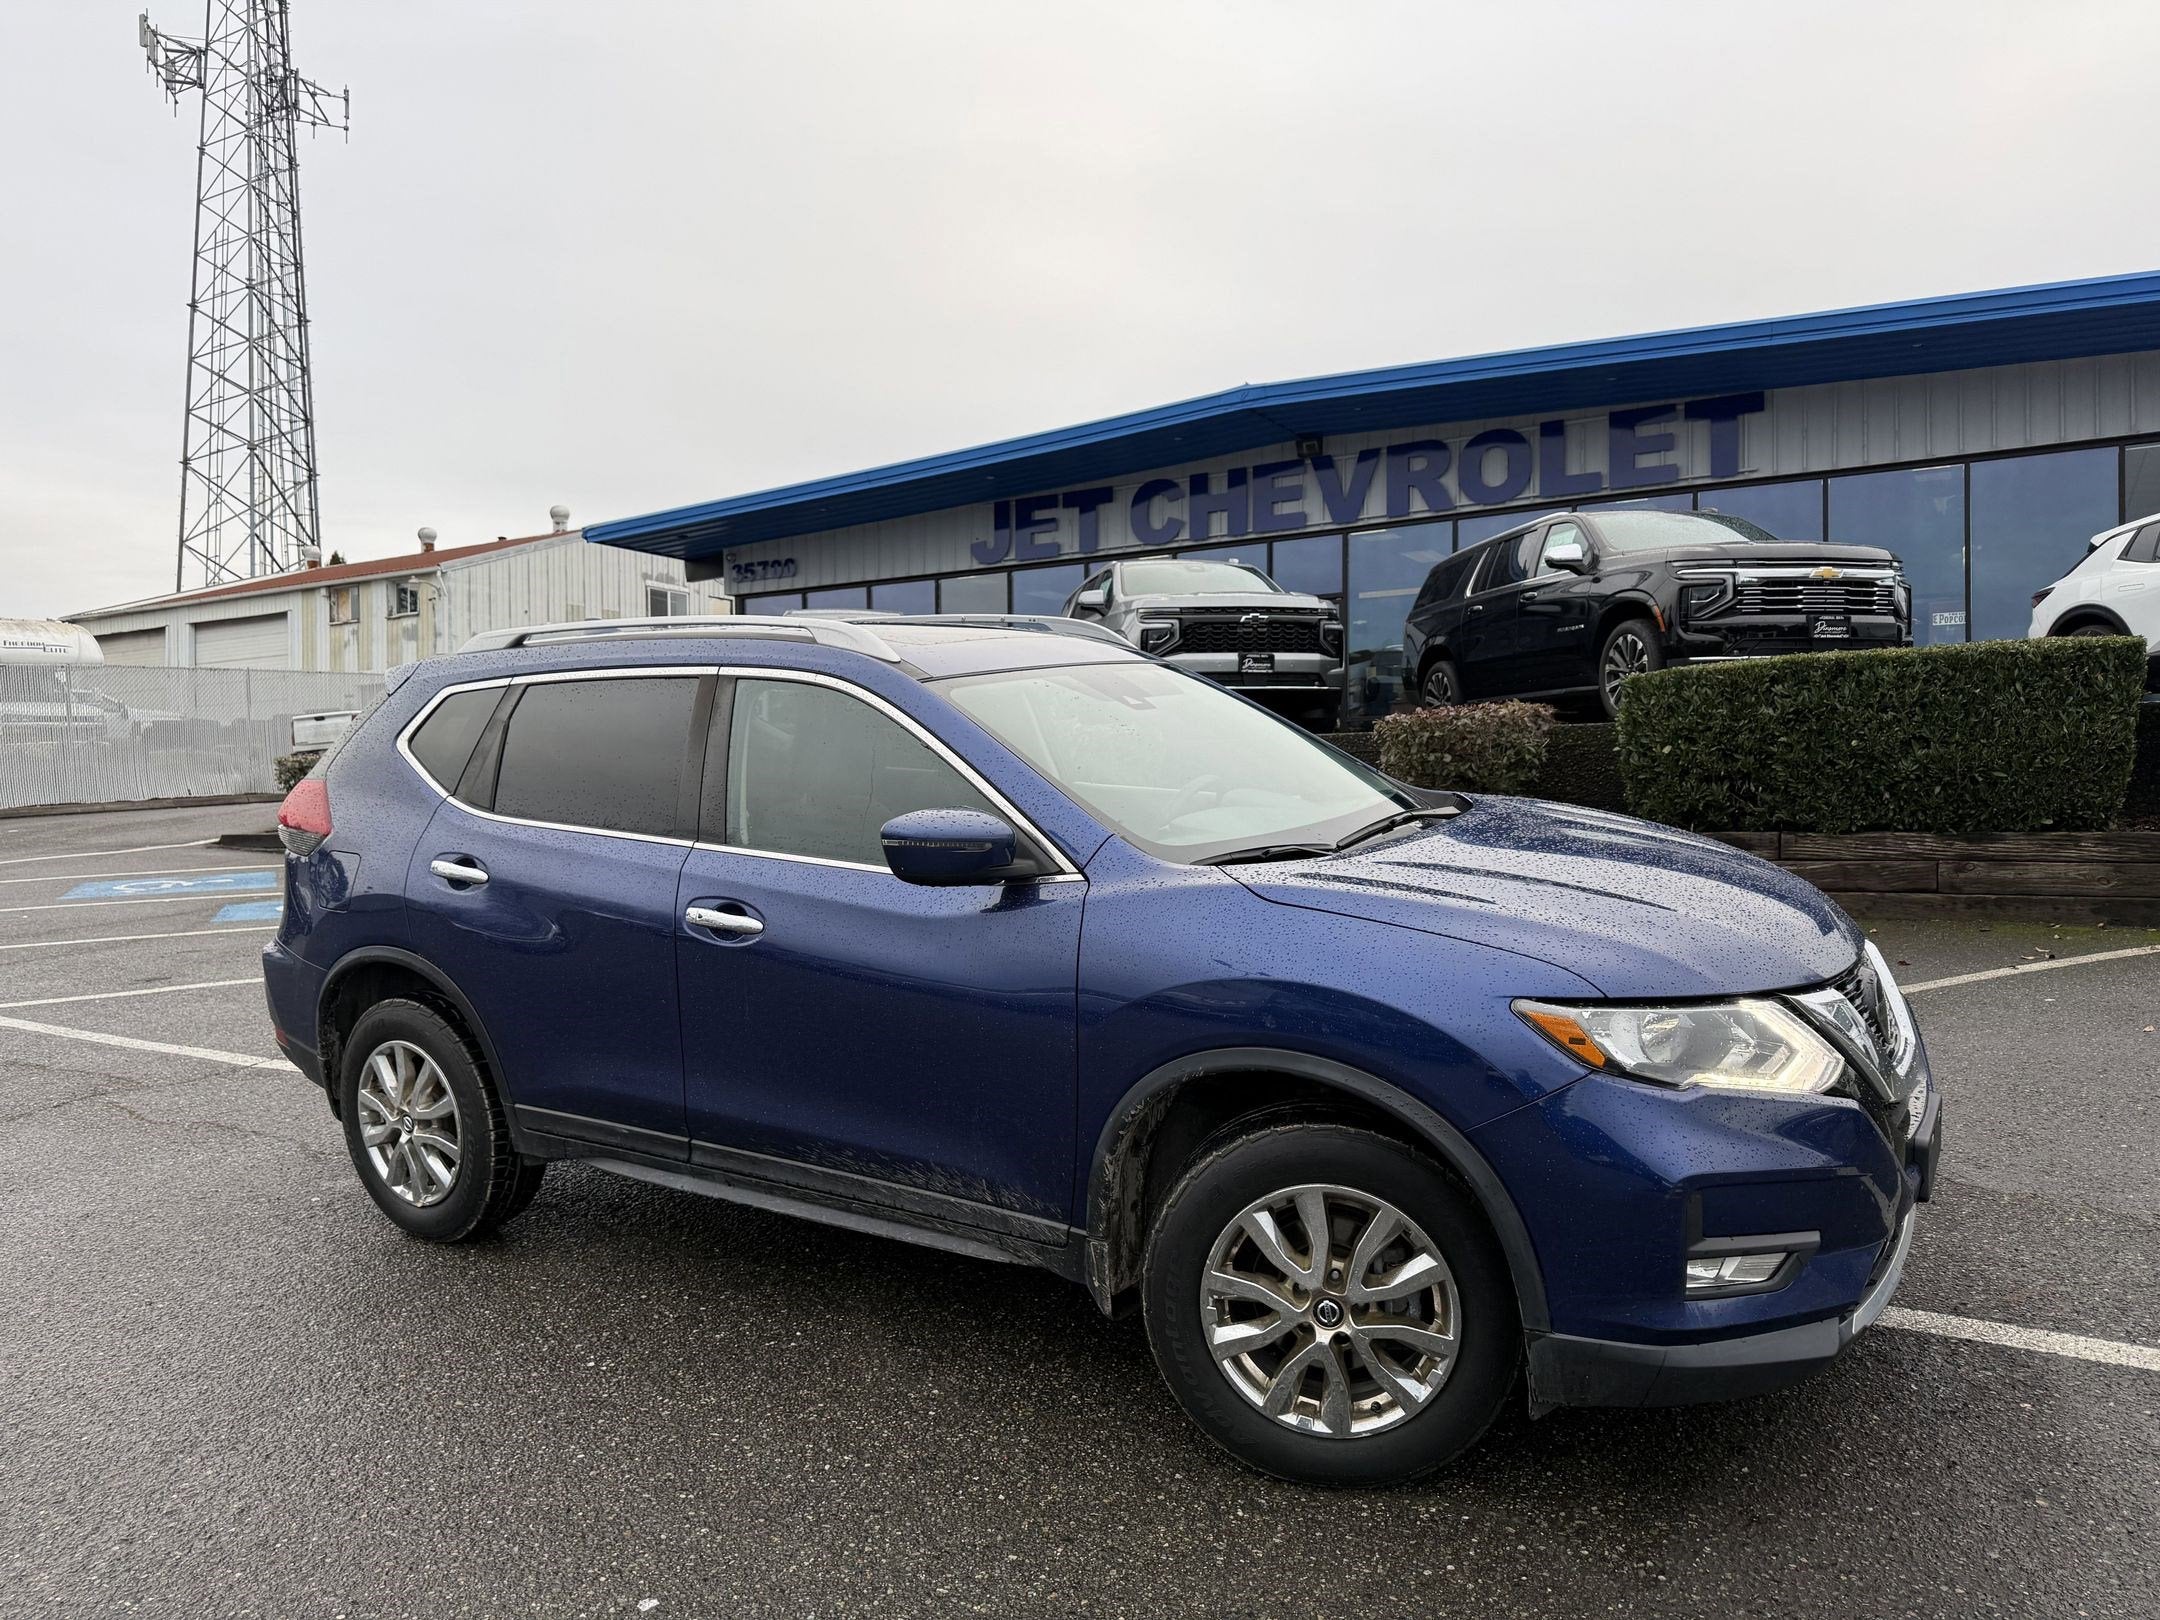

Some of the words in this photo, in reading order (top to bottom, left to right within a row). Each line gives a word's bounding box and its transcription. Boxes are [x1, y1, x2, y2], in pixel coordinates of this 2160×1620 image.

[970, 486, 1114, 565] JET
[1130, 391, 1765, 546] CHEVROLET
[732, 557, 798, 584] 35700
